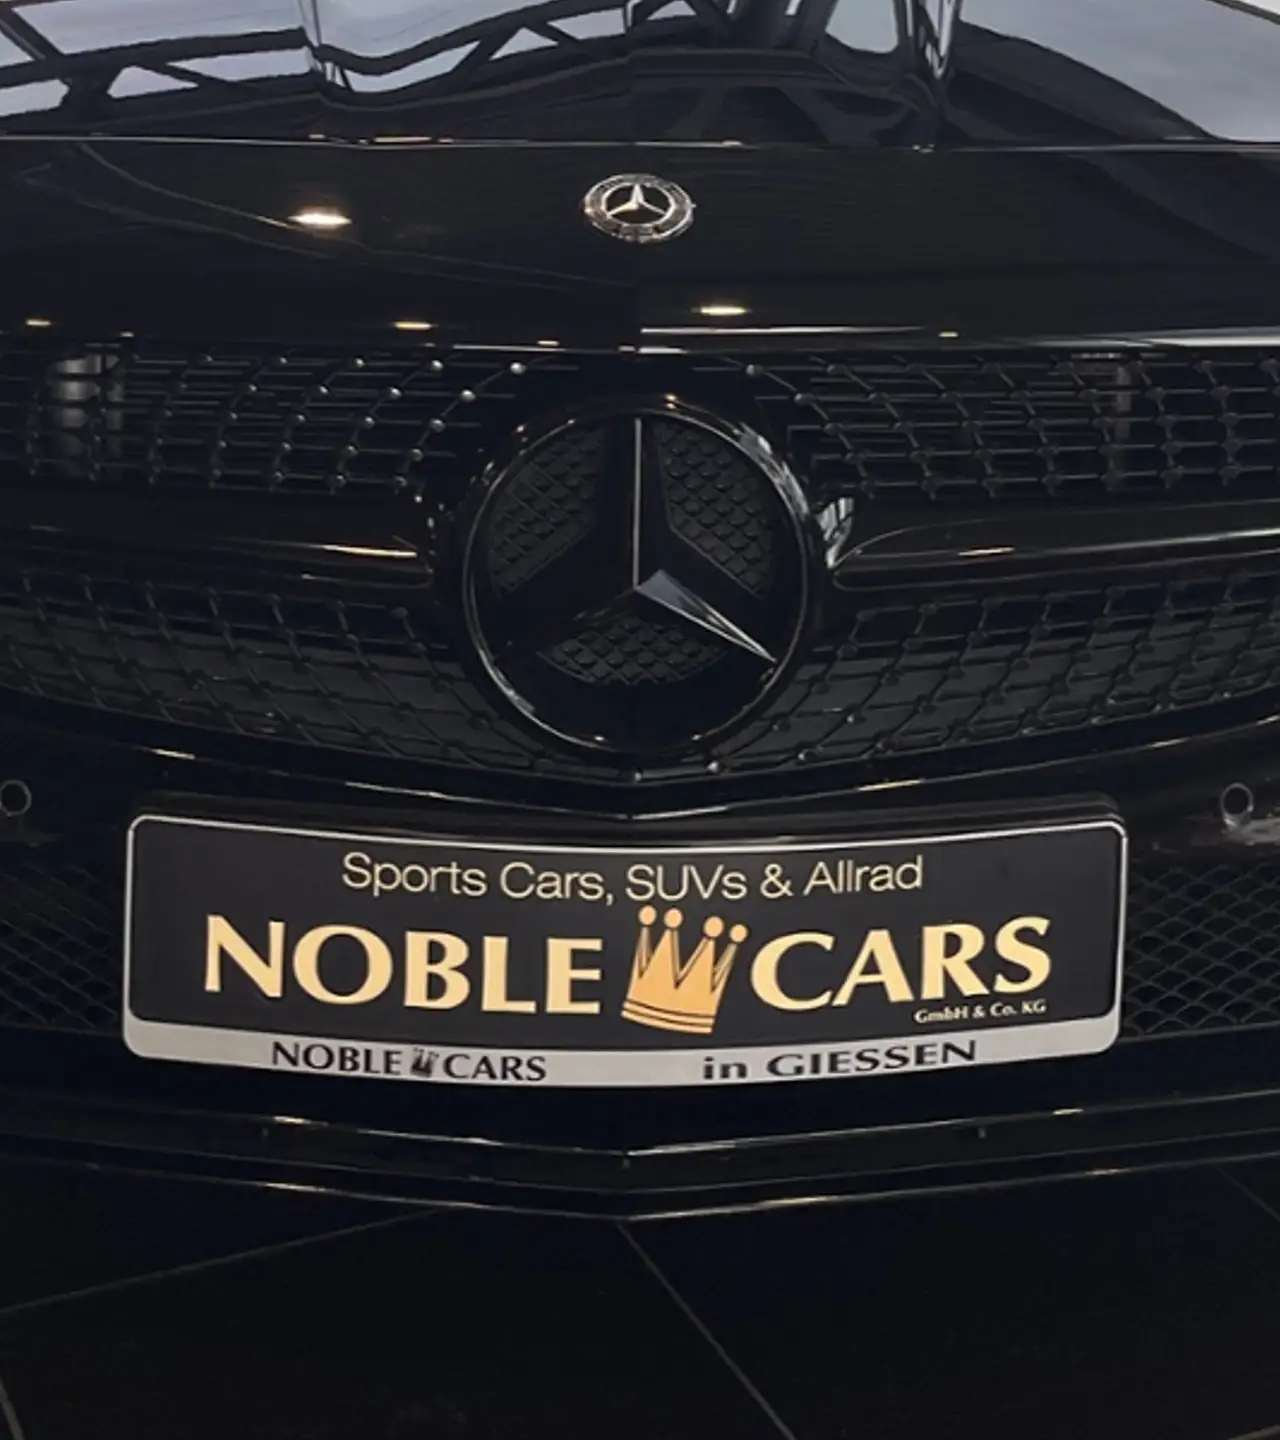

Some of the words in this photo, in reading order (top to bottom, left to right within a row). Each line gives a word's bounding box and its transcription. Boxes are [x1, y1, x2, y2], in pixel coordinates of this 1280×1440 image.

[341, 851, 488, 898] Sports
[499, 861, 614, 906] Cars,
[625, 863, 748, 901] SUVs
[759, 863, 794, 899] &
[802, 854, 925, 897] Allrad
[203, 913, 604, 1014] NOBLE
[750, 915, 1053, 1012] CARS
[913, 1005, 970, 1025] GmbH
[972, 1003, 986, 1019] &
[989, 1001, 1018, 1017] Co.
[1021, 997, 1048, 1015] KG
[270, 1040, 403, 1077] NOBLE
[442, 1054, 548, 1082] CARS
[702, 1055, 748, 1080] in
[765, 1039, 978, 1078] GIESSEN
